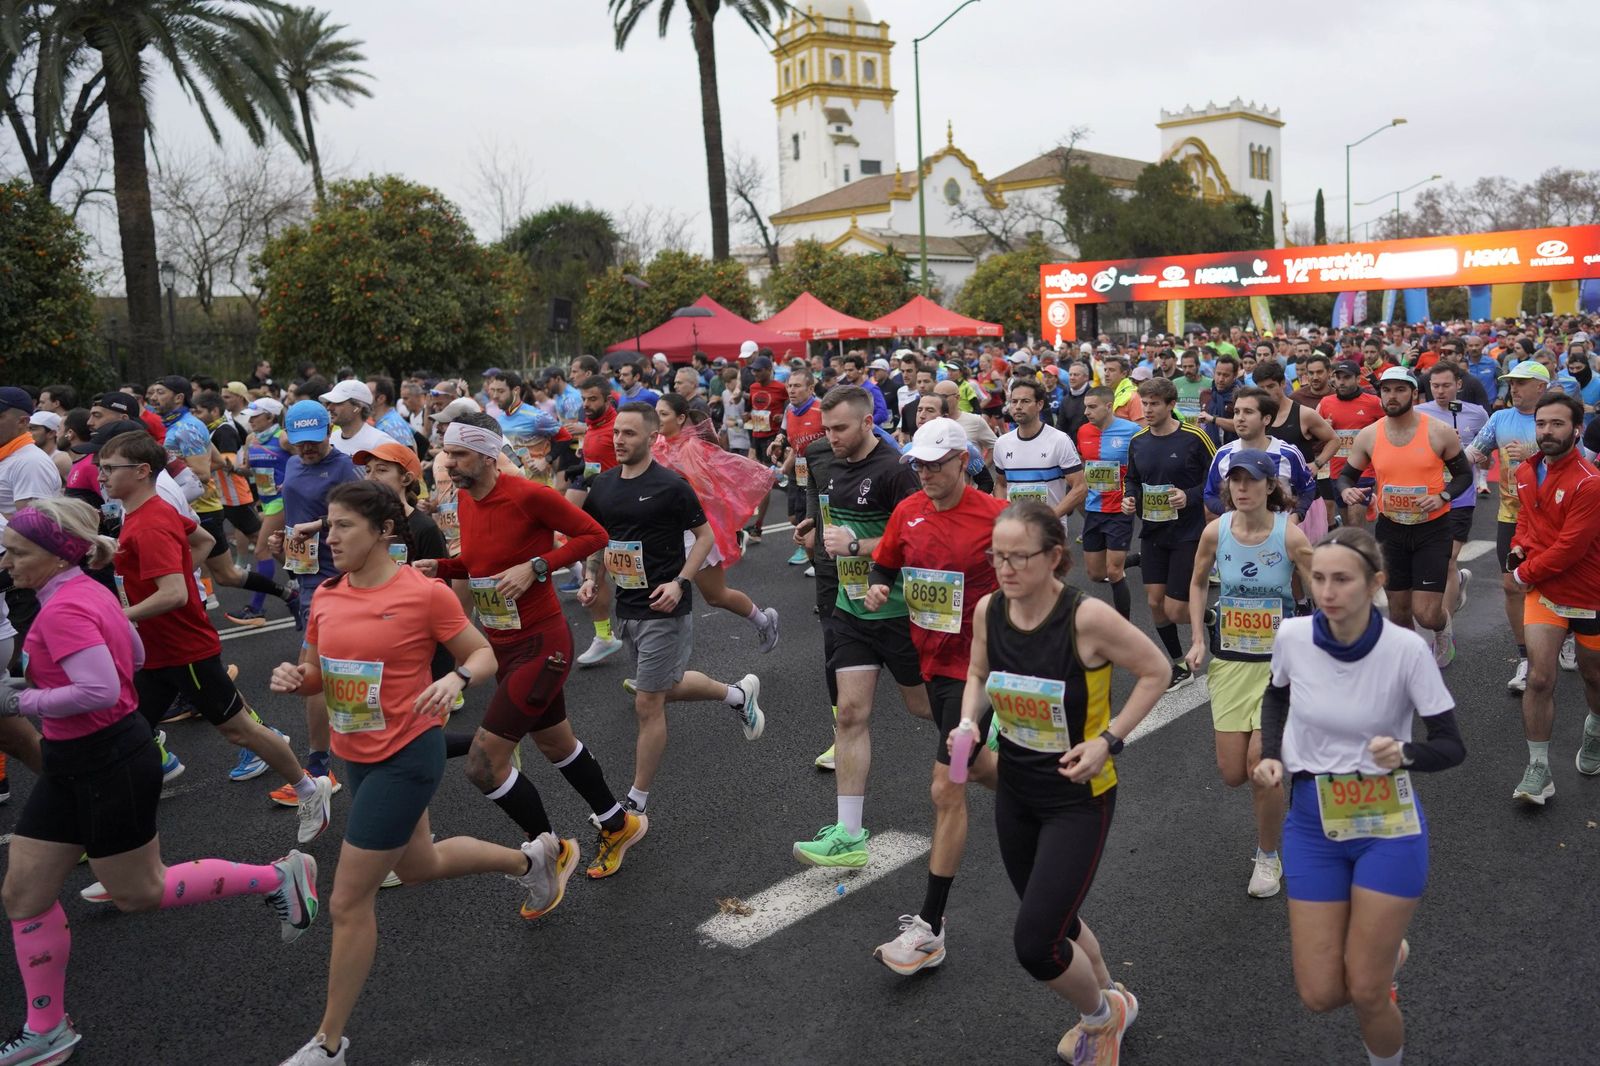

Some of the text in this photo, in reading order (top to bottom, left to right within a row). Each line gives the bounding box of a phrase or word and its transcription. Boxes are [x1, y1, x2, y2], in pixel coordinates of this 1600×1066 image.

[1463, 247, 1520, 268] HOKA
[293, 418, 318, 429] HOKA
[1090, 469, 1111, 479] 9277
[857, 496, 868, 505] EA
[608, 552, 632, 568] 7479
[839, 560, 870, 577] 10462
[911, 582, 948, 604] 8693
[1226, 610, 1273, 630] 15630
[994, 692, 1052, 720] 11693
[1331, 776, 1392, 806] 9923
